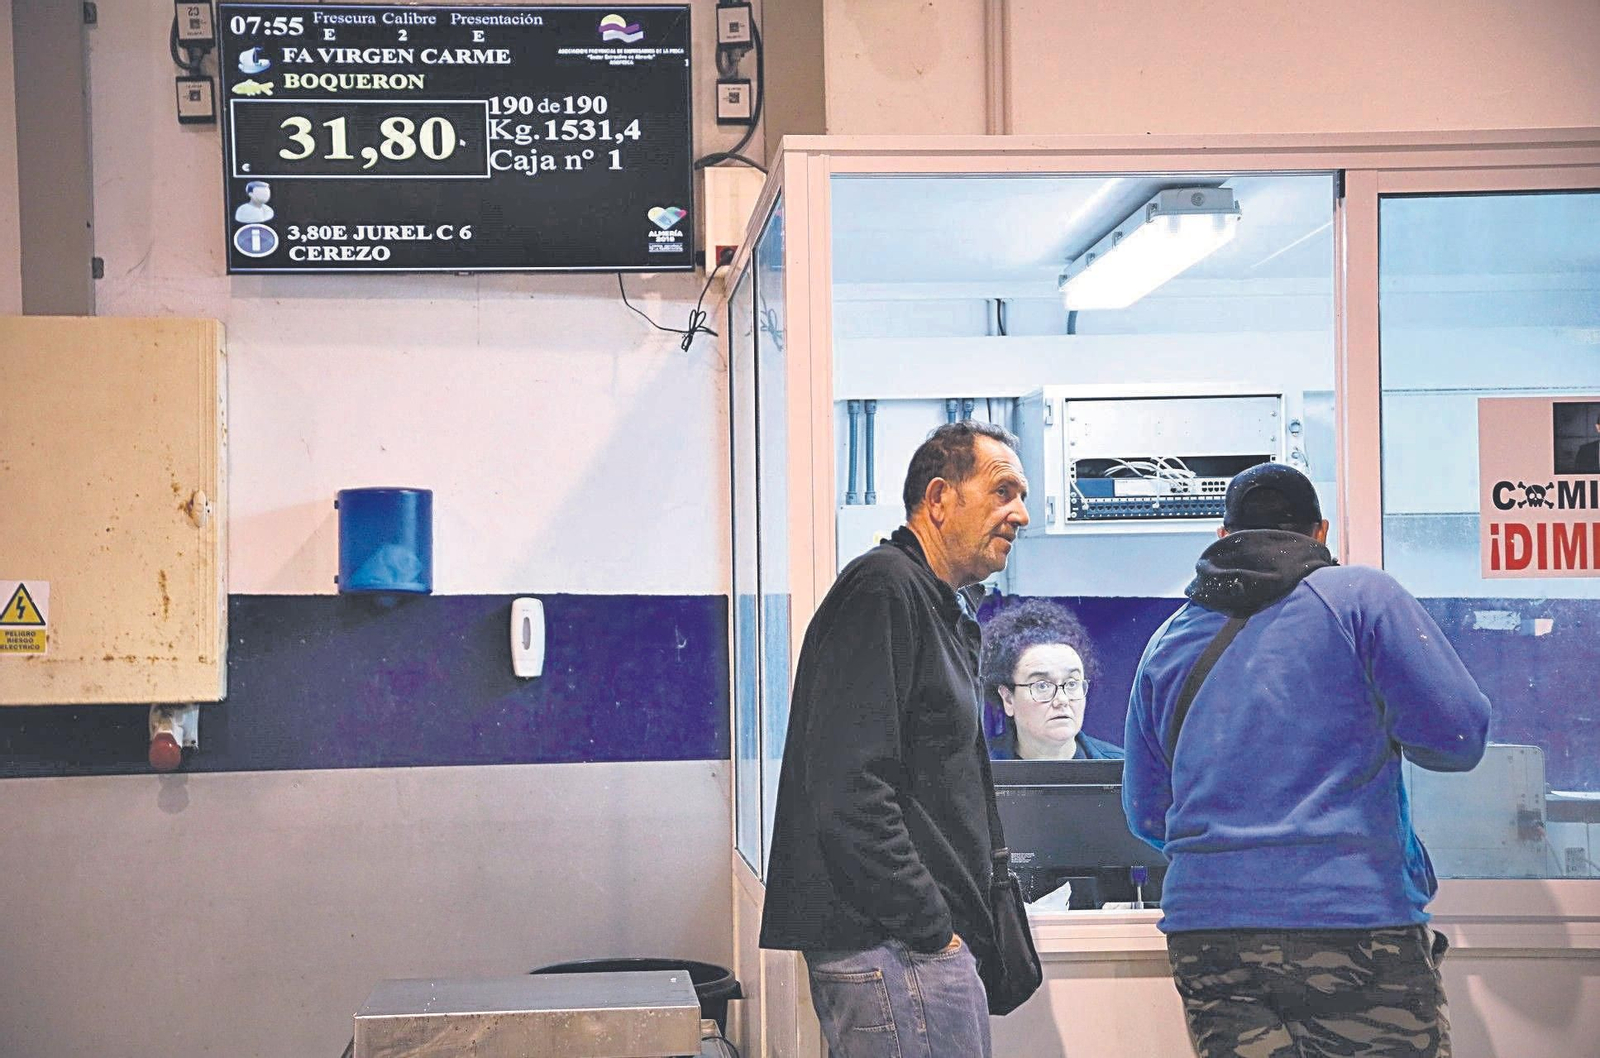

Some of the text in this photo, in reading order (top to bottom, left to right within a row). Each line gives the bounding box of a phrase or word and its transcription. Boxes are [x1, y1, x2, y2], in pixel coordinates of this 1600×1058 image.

[231, 16, 303, 35] 07:55
[314, 12, 543, 25] Frescura Calibre Presentación
[324, 29, 484, 42] E 2 E
[283, 48, 510, 64] FA VIRGEN CARME
[284, 74, 424, 91] BOQUERON
[490, 96, 607, 114] 190 de 190
[545, 119, 641, 144] 1531,4
[280, 117, 455, 168] 31,80
[491, 149, 556, 175] Caja
[609, 149, 622, 169] 1
[288, 225, 471, 242] 3,80E JUREL C 6
[289, 246, 390, 261] CEREZO
